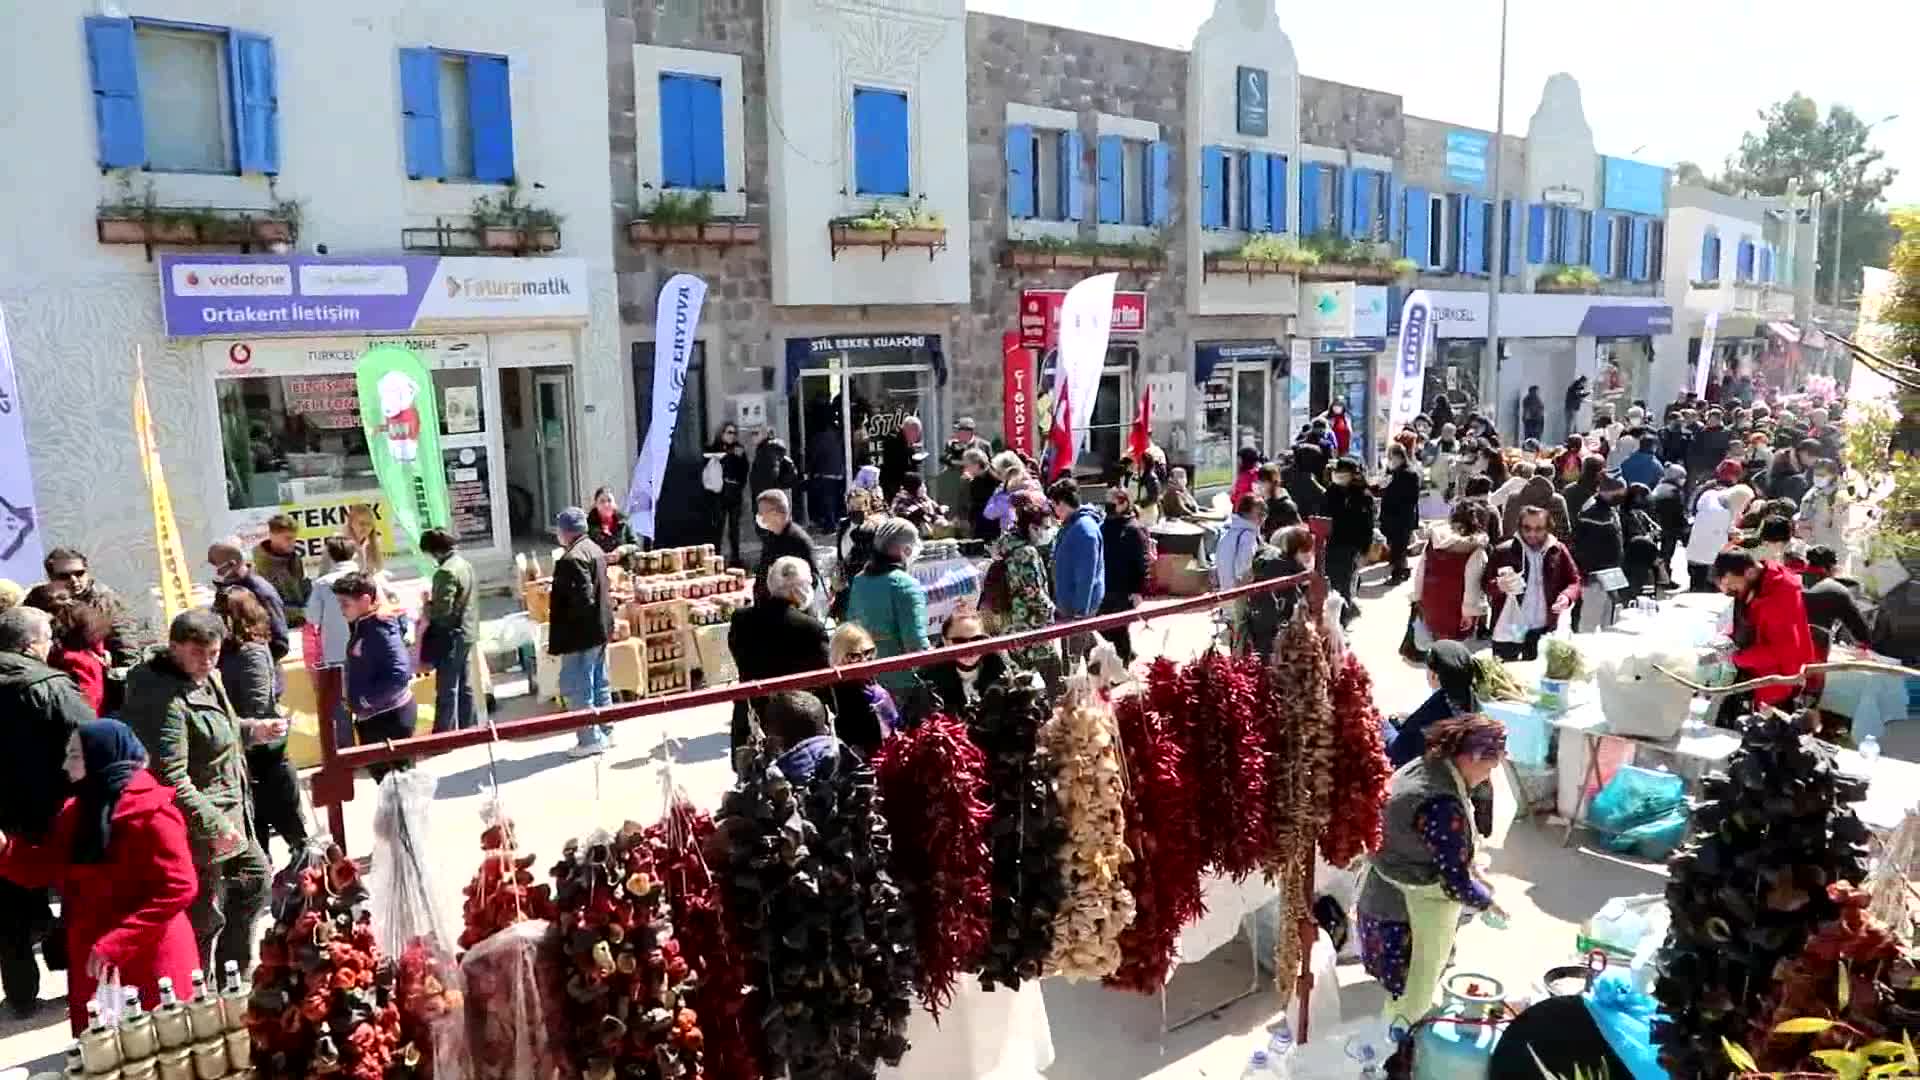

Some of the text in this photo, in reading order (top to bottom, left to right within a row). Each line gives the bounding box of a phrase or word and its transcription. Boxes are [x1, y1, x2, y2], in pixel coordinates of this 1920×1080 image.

[208, 270, 285, 286] vodafone
[202, 303, 360, 324] Ortakent İletişim
[811, 337, 833, 351] STİL
[287, 503, 382, 529] TEKNK
